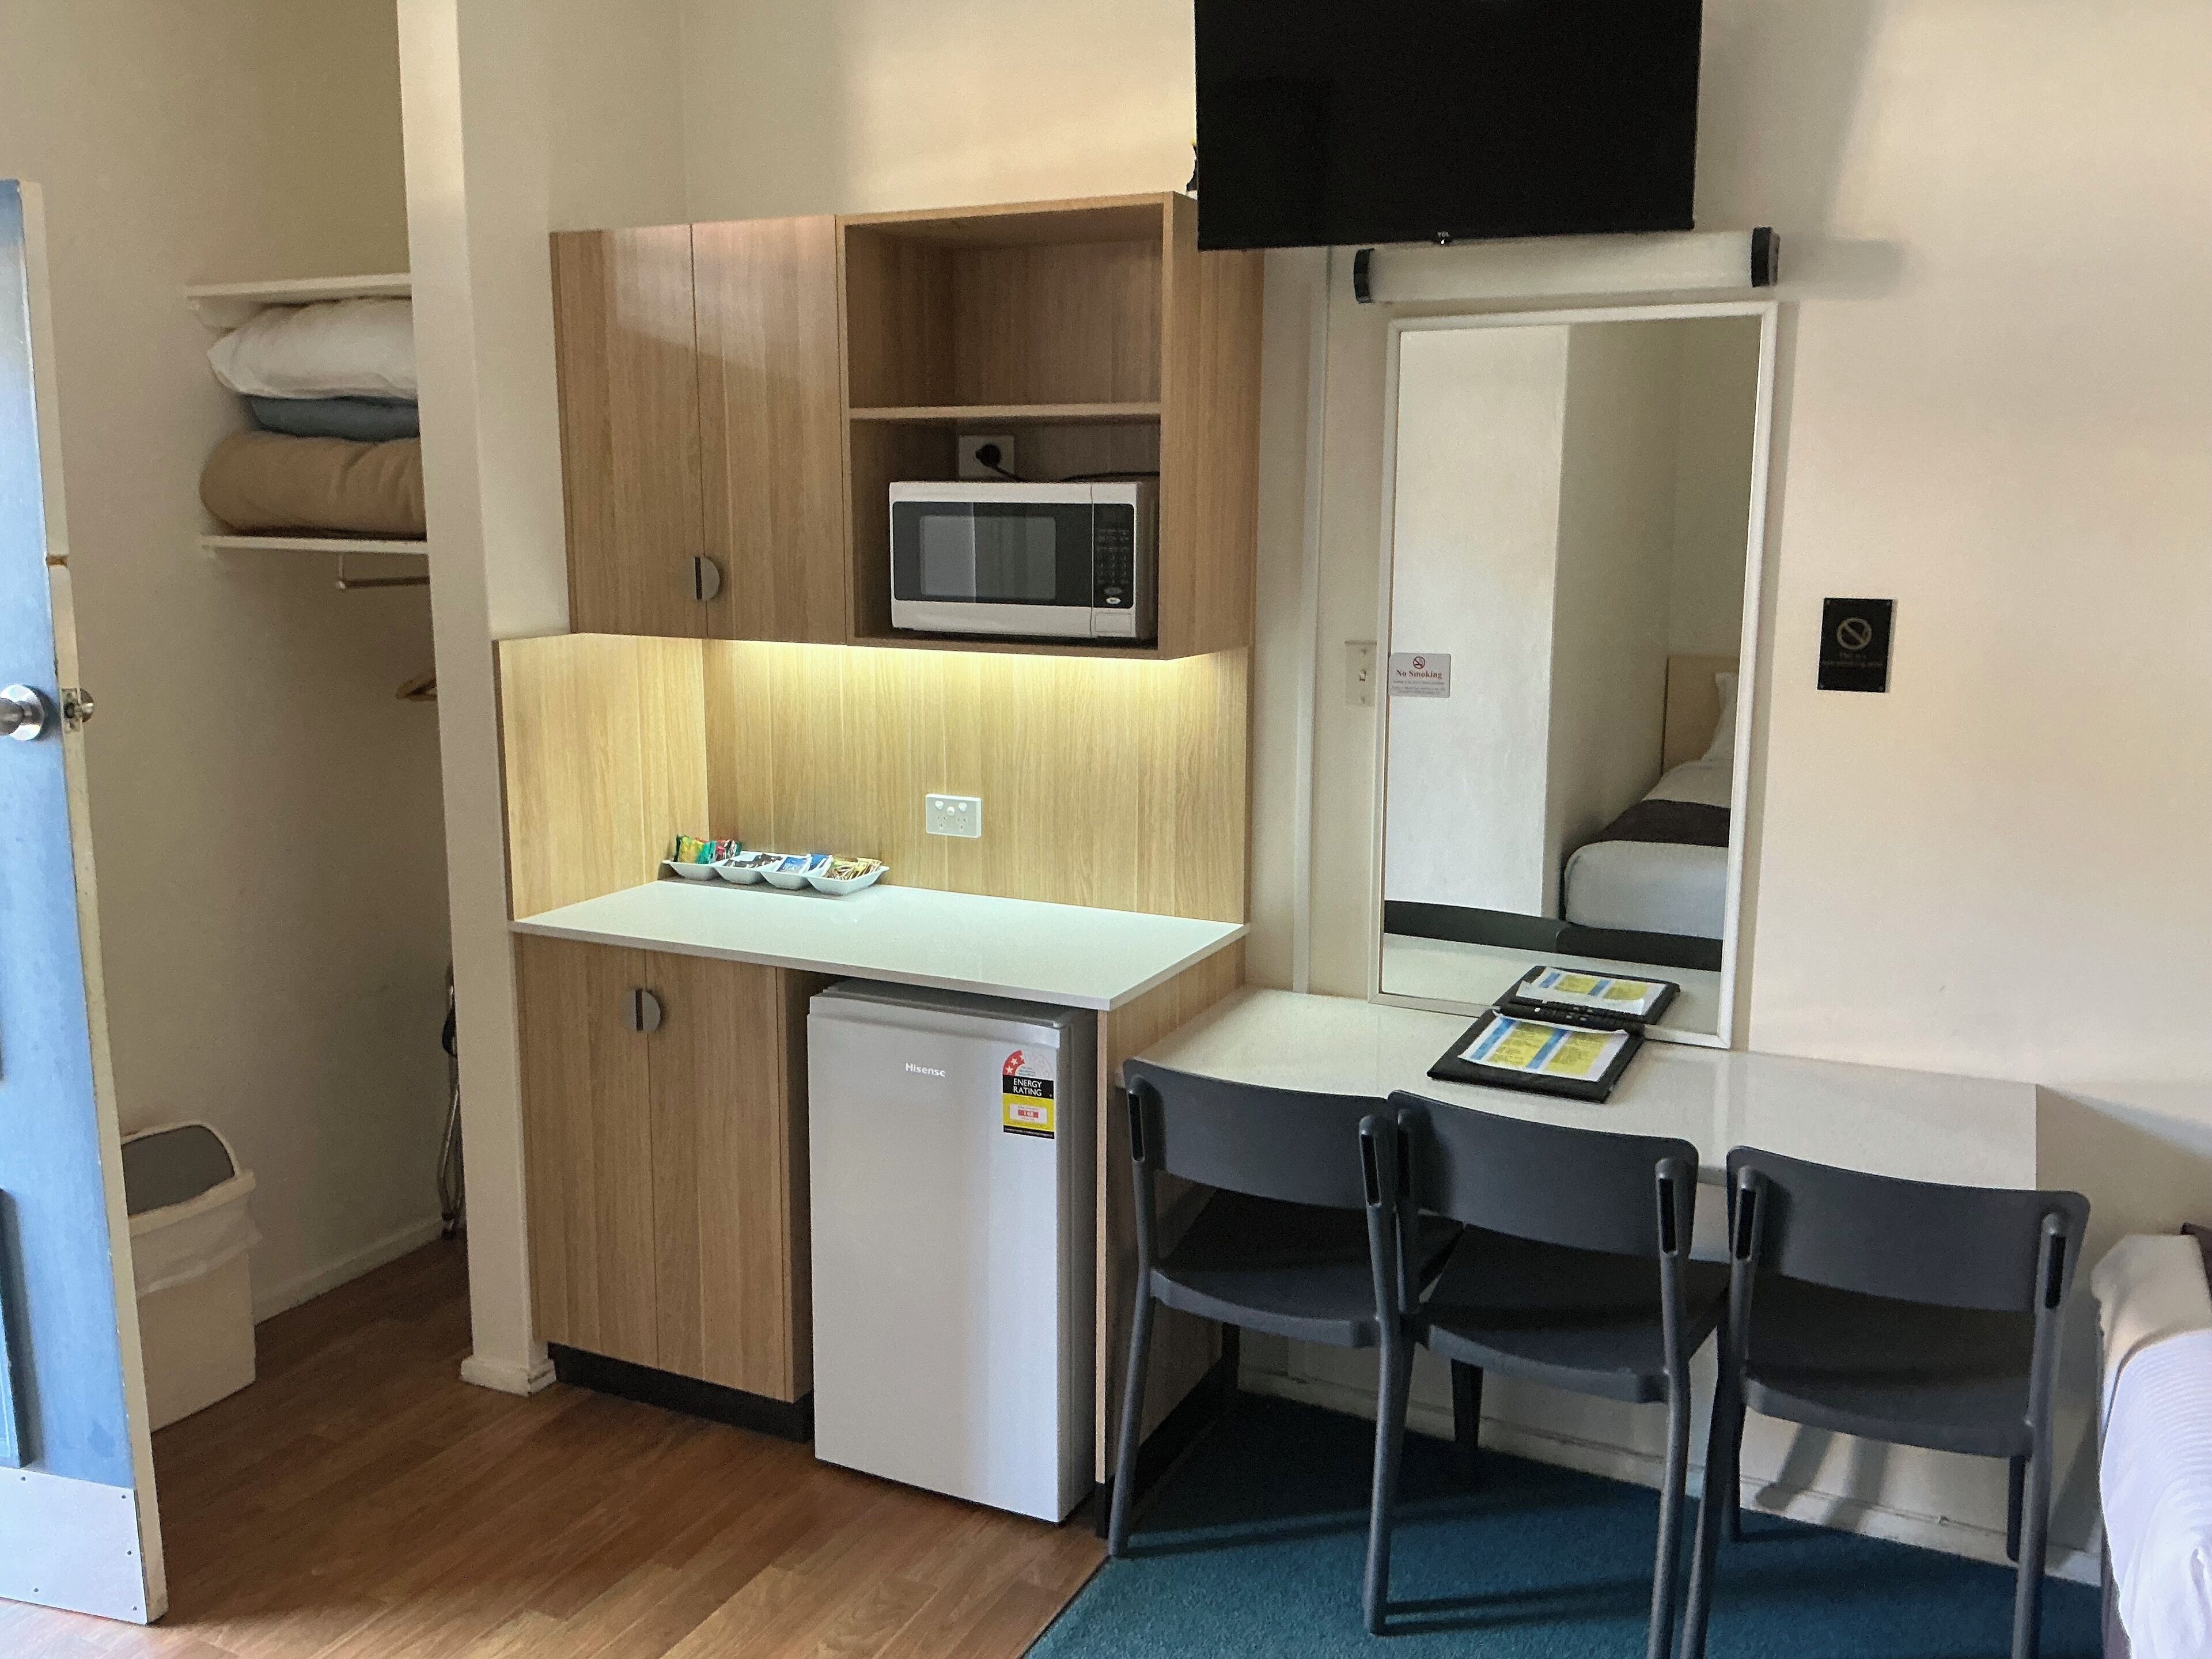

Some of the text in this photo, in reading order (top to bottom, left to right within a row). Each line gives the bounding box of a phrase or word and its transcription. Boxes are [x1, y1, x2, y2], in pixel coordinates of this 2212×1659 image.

[1396, 669, 1443, 679] No Smoking
[905, 1063, 946, 1077] Hisense
[1013, 1078, 1043, 1088] ENERGY
[1013, 1086, 1042, 1097] RATING
